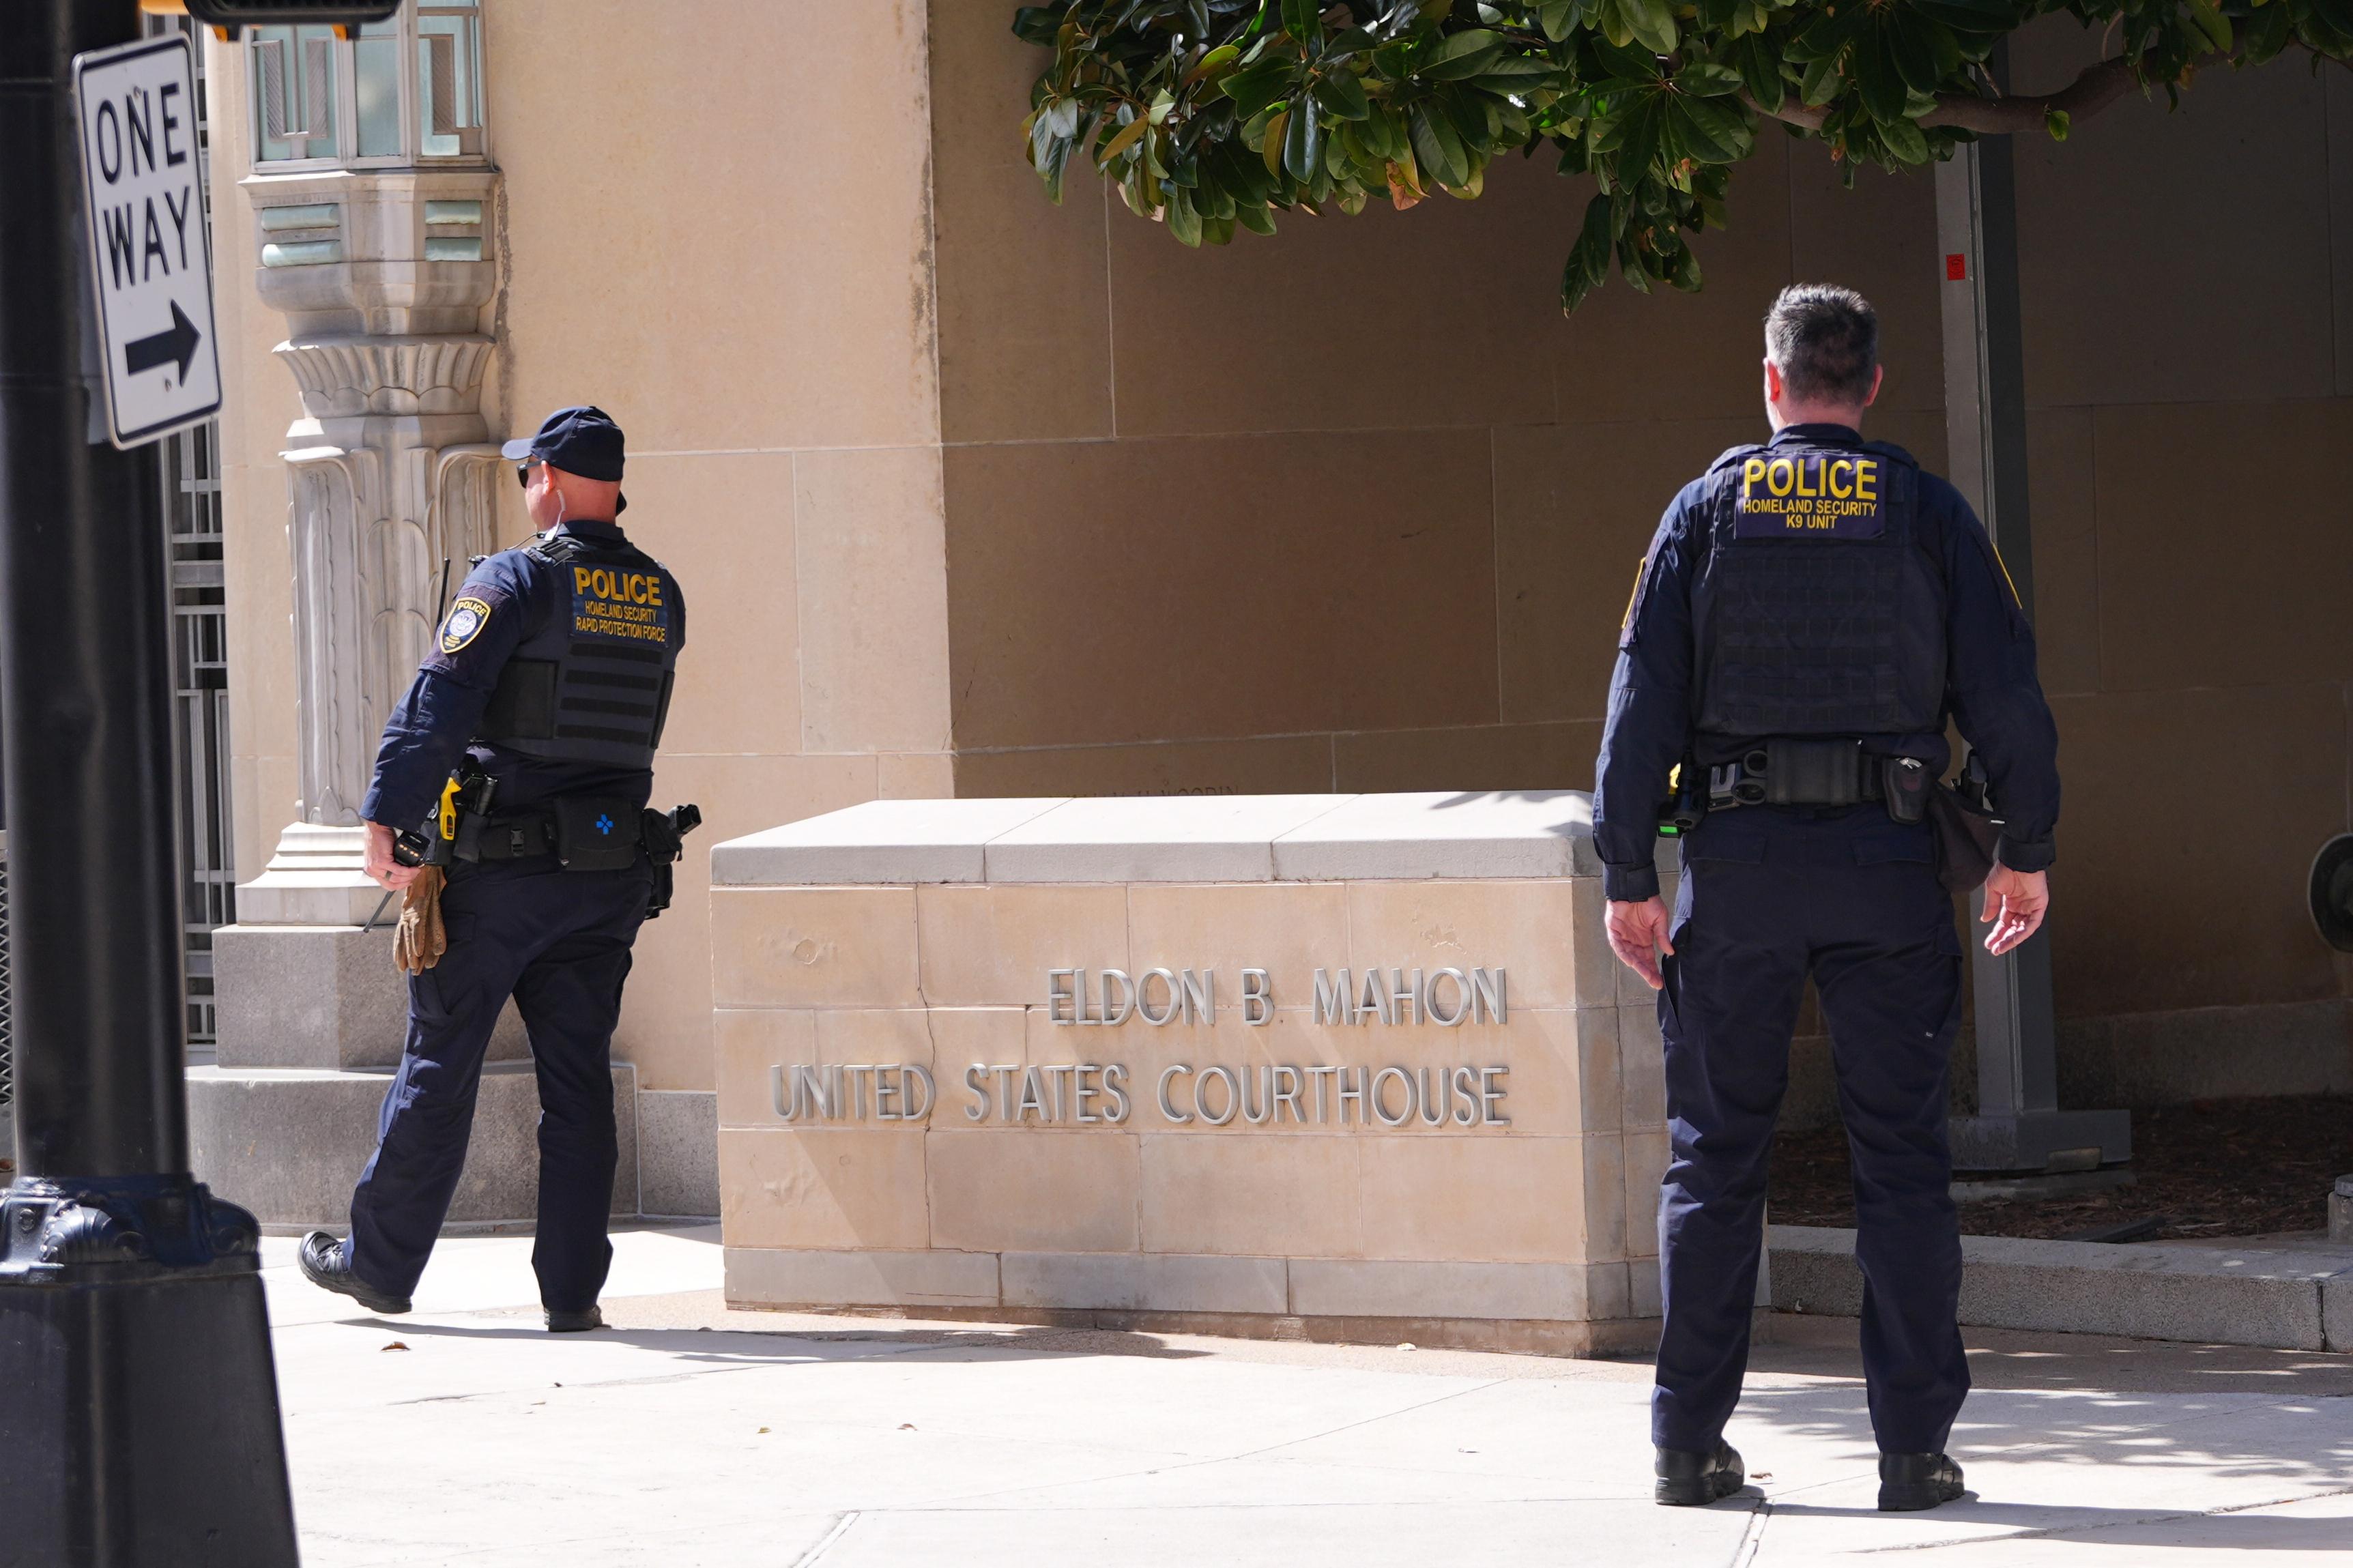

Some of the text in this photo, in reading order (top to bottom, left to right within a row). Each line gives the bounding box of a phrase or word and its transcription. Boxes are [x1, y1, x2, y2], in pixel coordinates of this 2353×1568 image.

[97, 81, 187, 185] ONE
[104, 185, 190, 291] WAY
[1744, 458, 1877, 500] POLICE
[1743, 499, 1877, 517] HOMELAND SECURITY
[1786, 514, 1838, 529] K9 UNIT
[574, 567, 662, 606] POLICE
[458, 601, 487, 617] POLICE
[585, 600, 656, 622] HOMELAND SECURITY
[576, 616, 666, 642] RAPID PROTECTION FORCE
[1048, 968, 1507, 1027] ELDON B MAHON
[771, 1062, 1512, 1127] UNITED STATES COURTHOUSE
